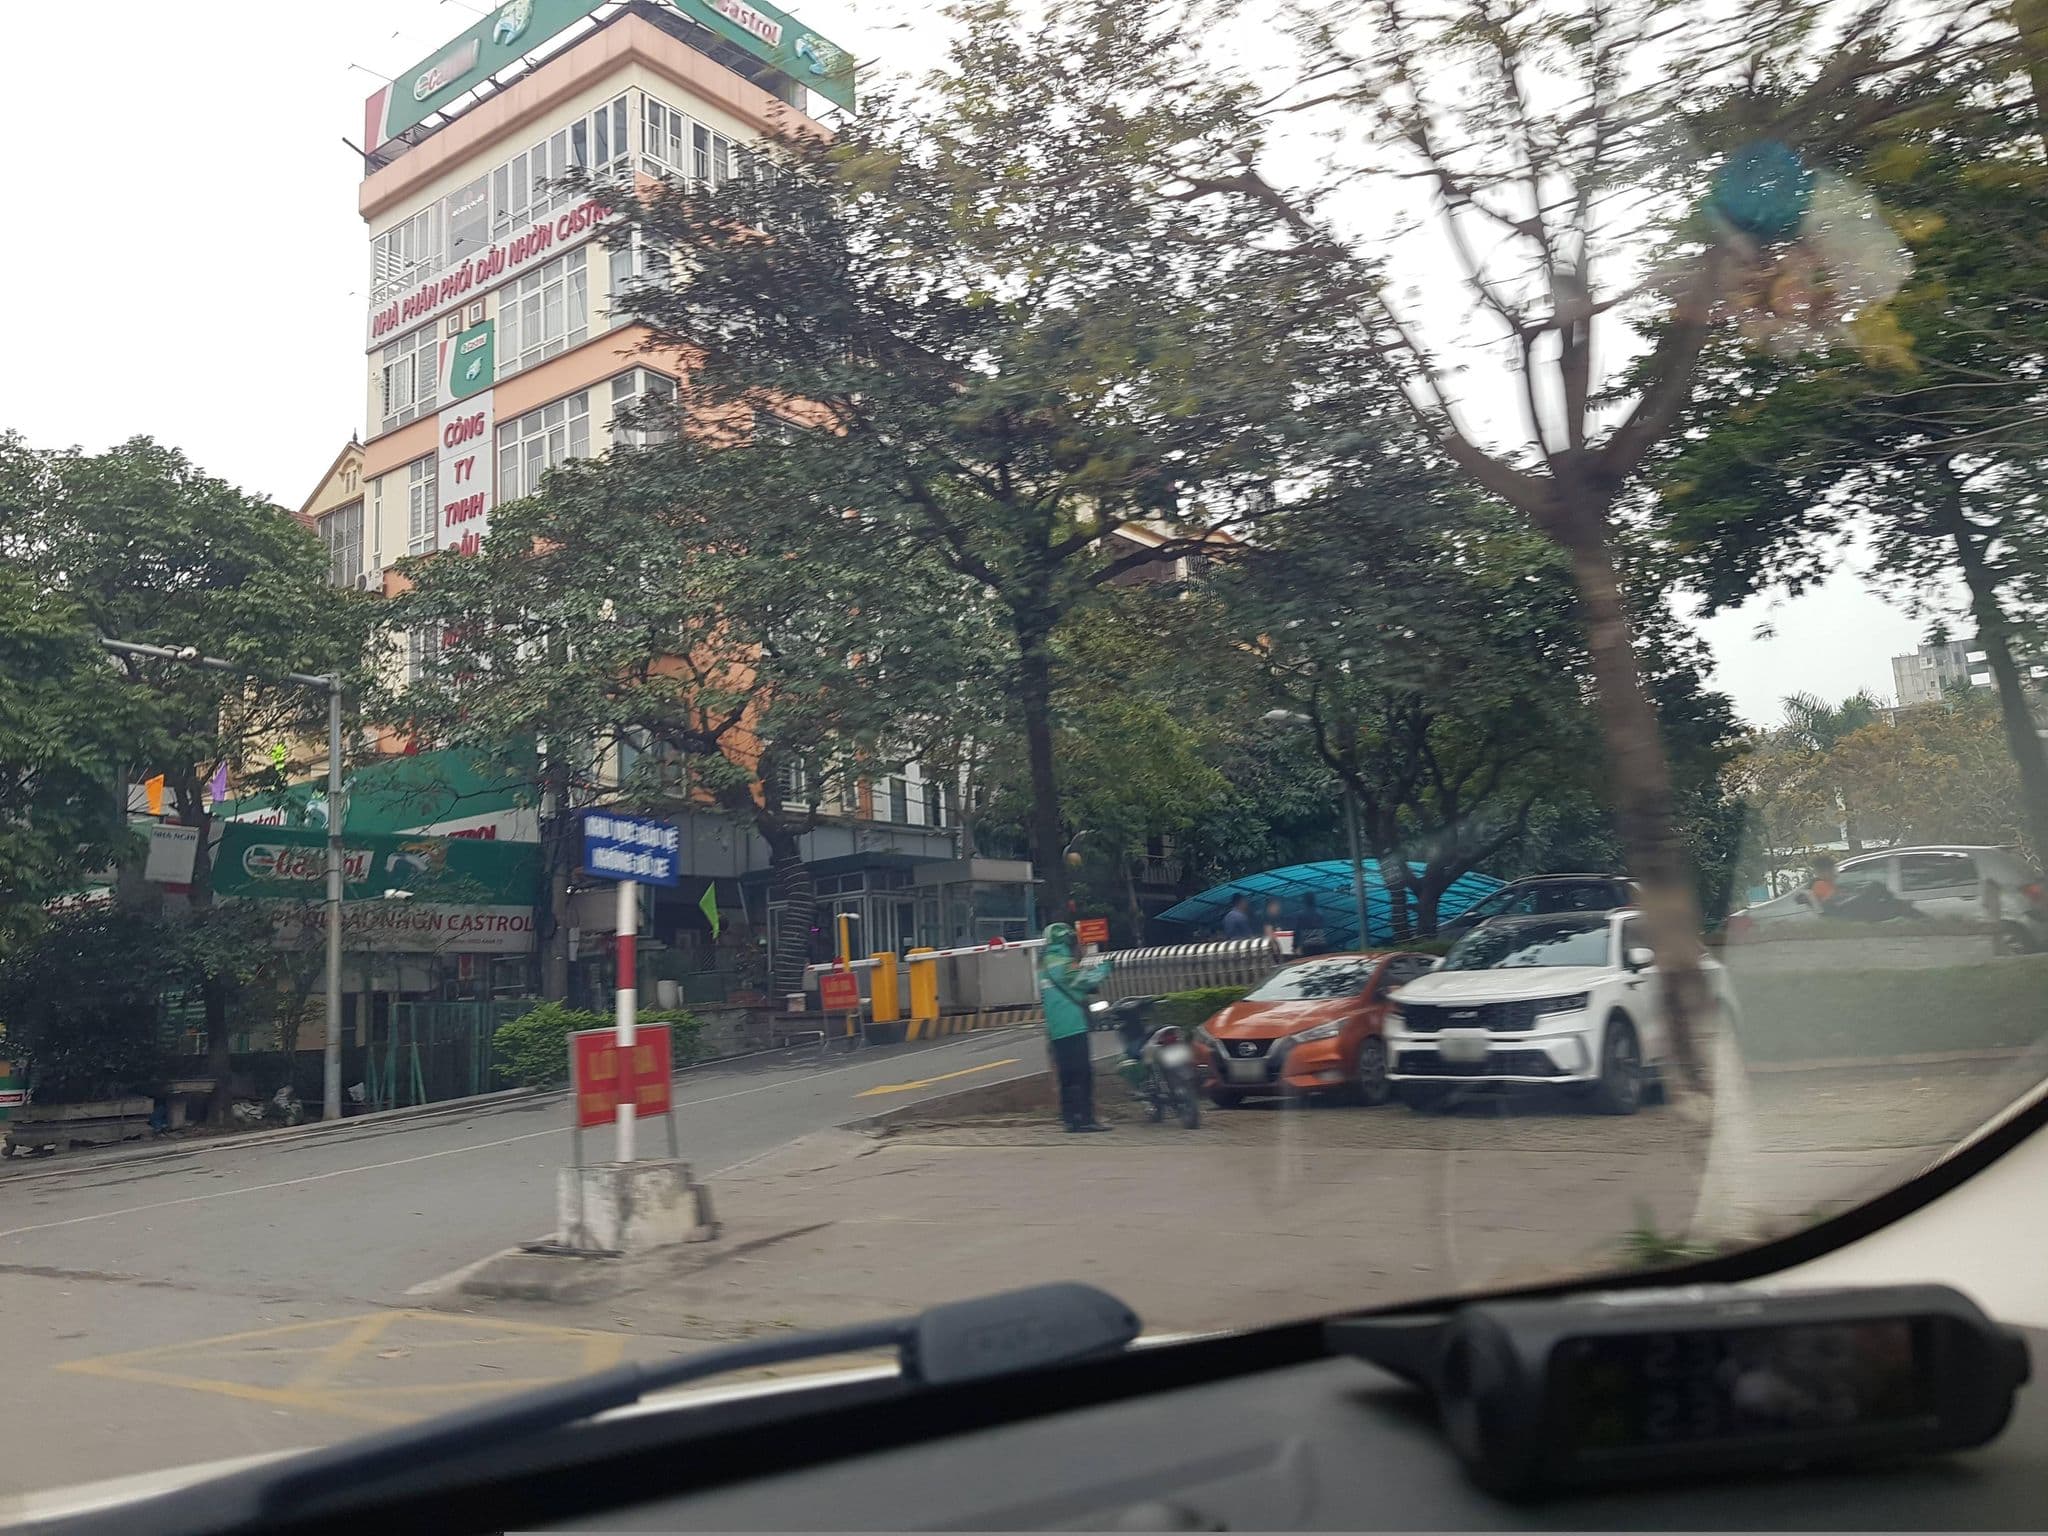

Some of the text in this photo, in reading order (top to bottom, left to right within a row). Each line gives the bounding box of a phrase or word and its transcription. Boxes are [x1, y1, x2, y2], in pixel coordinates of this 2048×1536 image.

[372, 302, 399, 338] NHÀ
[402, 279, 439, 322] PHÂN
[439, 259, 473, 304] PHỐI
[508, 220, 554, 268] NHỜN
[444, 411, 485, 448] CÔNG
[454, 455, 476, 484] TY
[444, 492, 485, 528] TNHH
[447, 913, 535, 933] CASTROL
